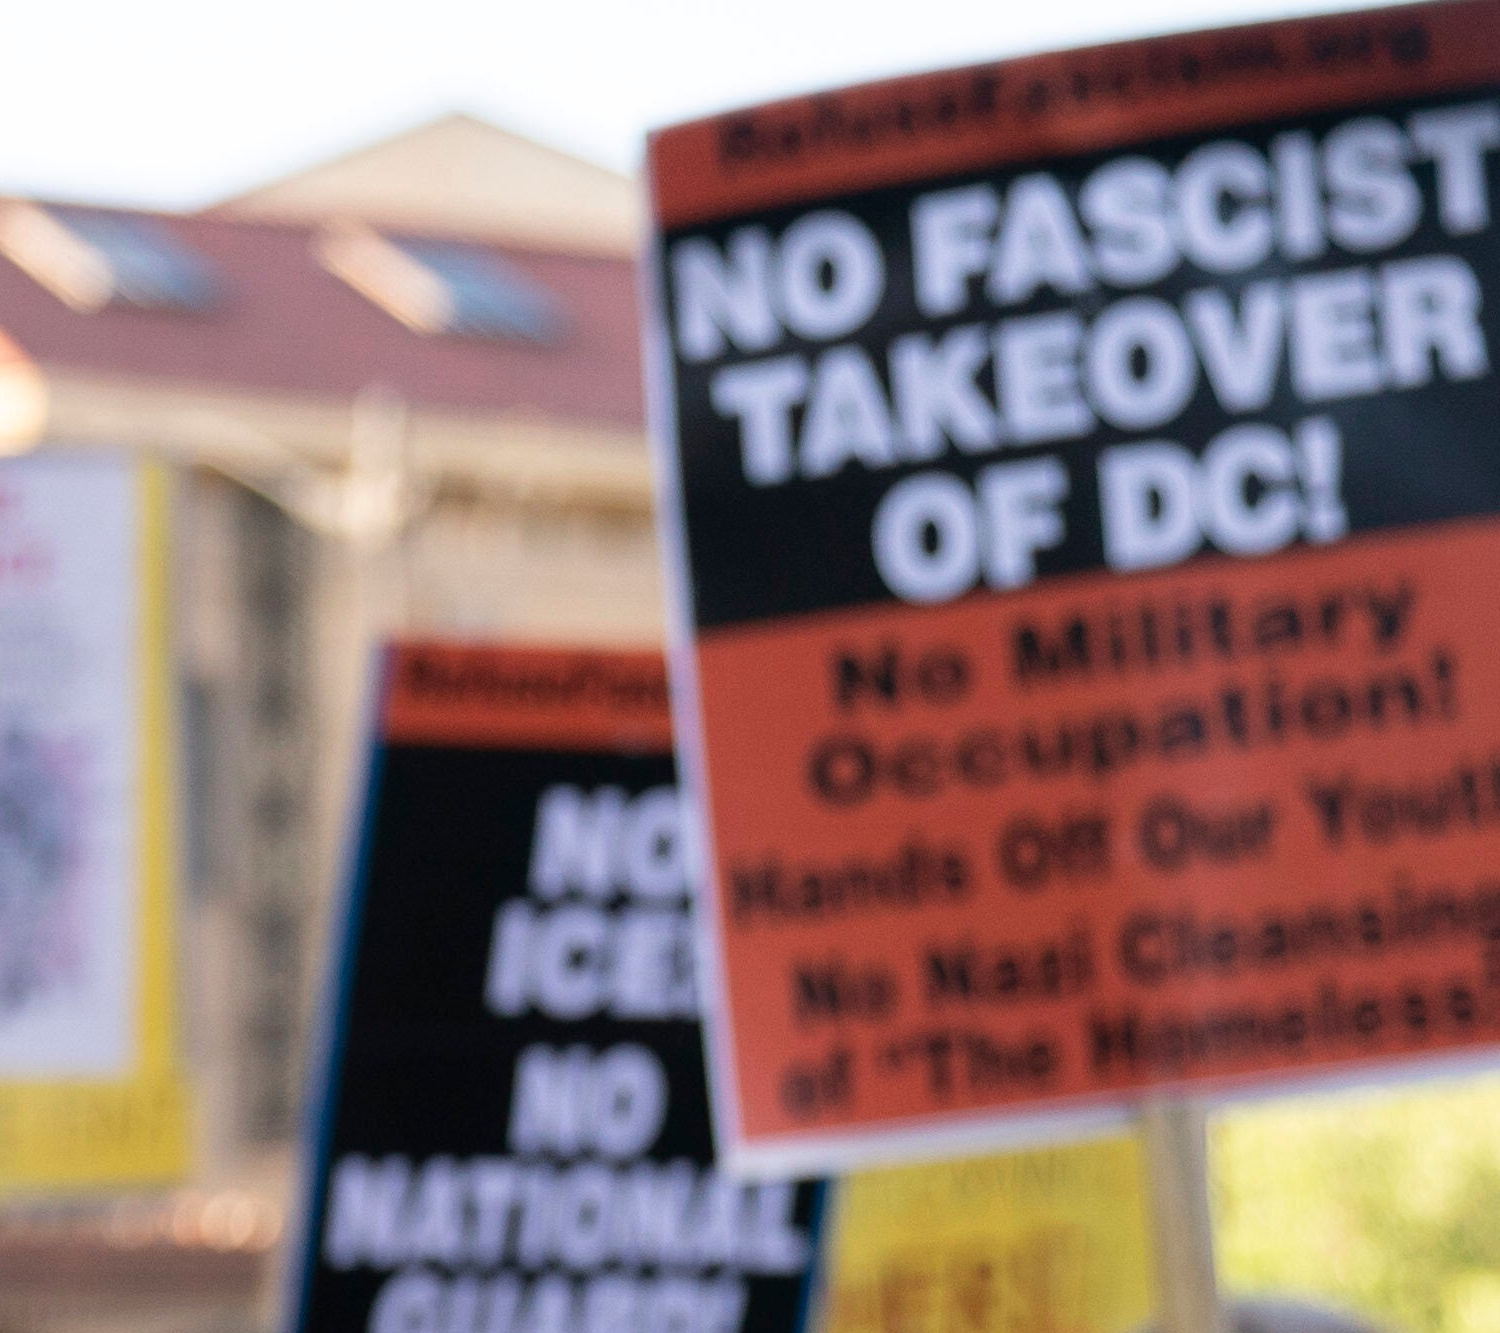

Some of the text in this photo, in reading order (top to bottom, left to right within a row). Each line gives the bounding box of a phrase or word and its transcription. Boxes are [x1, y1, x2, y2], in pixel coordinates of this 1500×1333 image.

[668, 98, 1500, 364] NO FASCIST
[707, 253, 1491, 487] TAKEOVER
[871, 415, 1350, 604] OF DC!
[831, 580, 1416, 712] No Military
[808, 648, 1458, 806] Occupation!
[527, 783, 692, 900] NO
[732, 752, 1500, 930] Hands Off Our Yout
[507, 1041, 668, 1160] NO
[322, 1155, 812, 1277] NATIONAL
